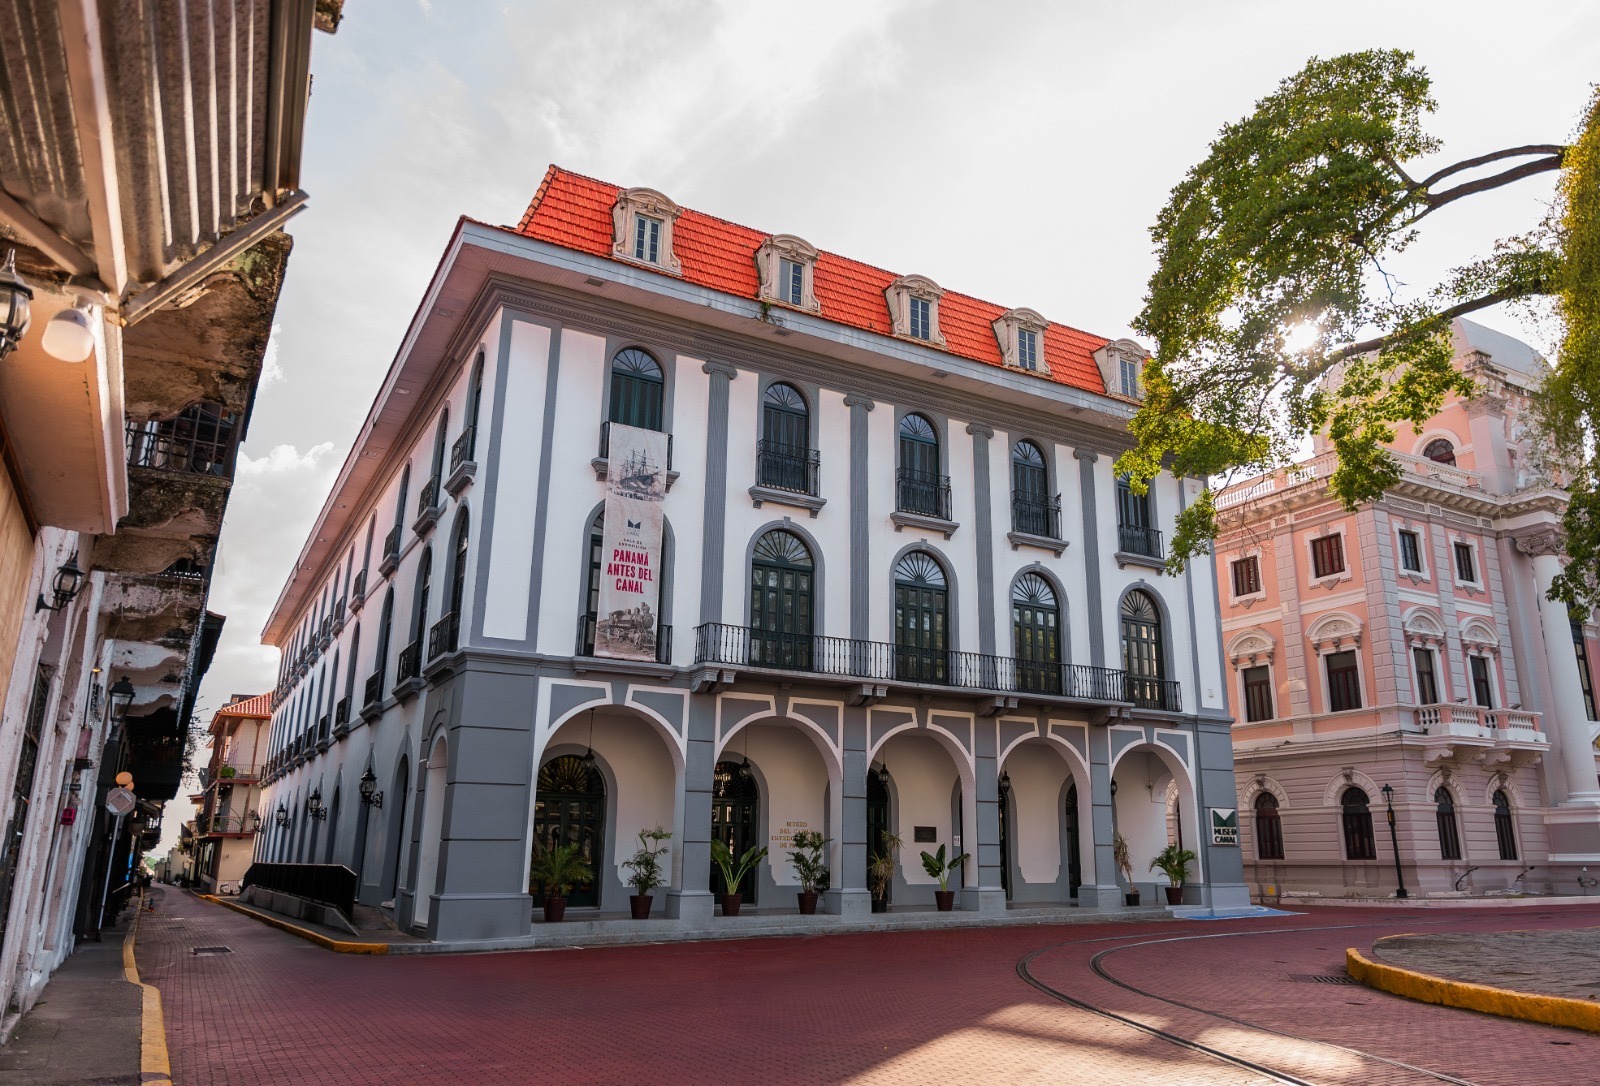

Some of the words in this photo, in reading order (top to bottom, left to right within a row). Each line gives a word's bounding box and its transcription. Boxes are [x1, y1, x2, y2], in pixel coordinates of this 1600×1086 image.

[613, 549, 649, 566] PANAMÁ
[607, 562, 636, 578] ANTES
[638, 568, 653, 582] DEL
[616, 578, 644, 594] CANAL
